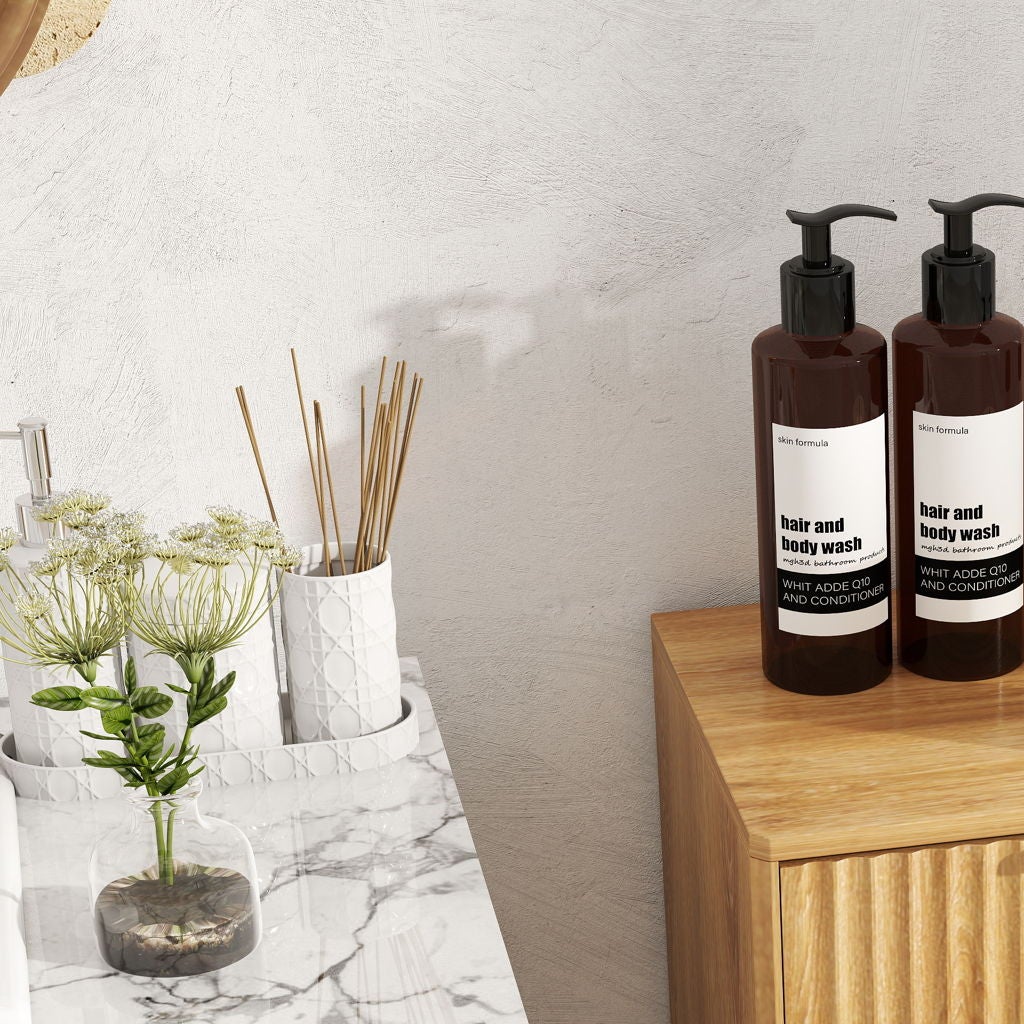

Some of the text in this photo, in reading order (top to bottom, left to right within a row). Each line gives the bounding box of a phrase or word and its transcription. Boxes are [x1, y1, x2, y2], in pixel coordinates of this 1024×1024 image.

[918, 423, 969, 435] skin formula
[778, 436, 829, 447] skin formula
[919, 501, 983, 520] hair and
[780, 514, 844, 533] hair and
[920, 522, 1000, 543] body wash
[781, 535, 862, 556] body wash
[952, 544, 993, 554] bathroom
[814, 558, 857, 567] bathroom
[920, 562, 1008, 579] WHIT ADDE Q10
[782, 576, 871, 593] WHIT ADDE Q10
[920, 569, 1021, 592] AND CONDITIONER
[783, 583, 885, 606] AND CONDITIONER
